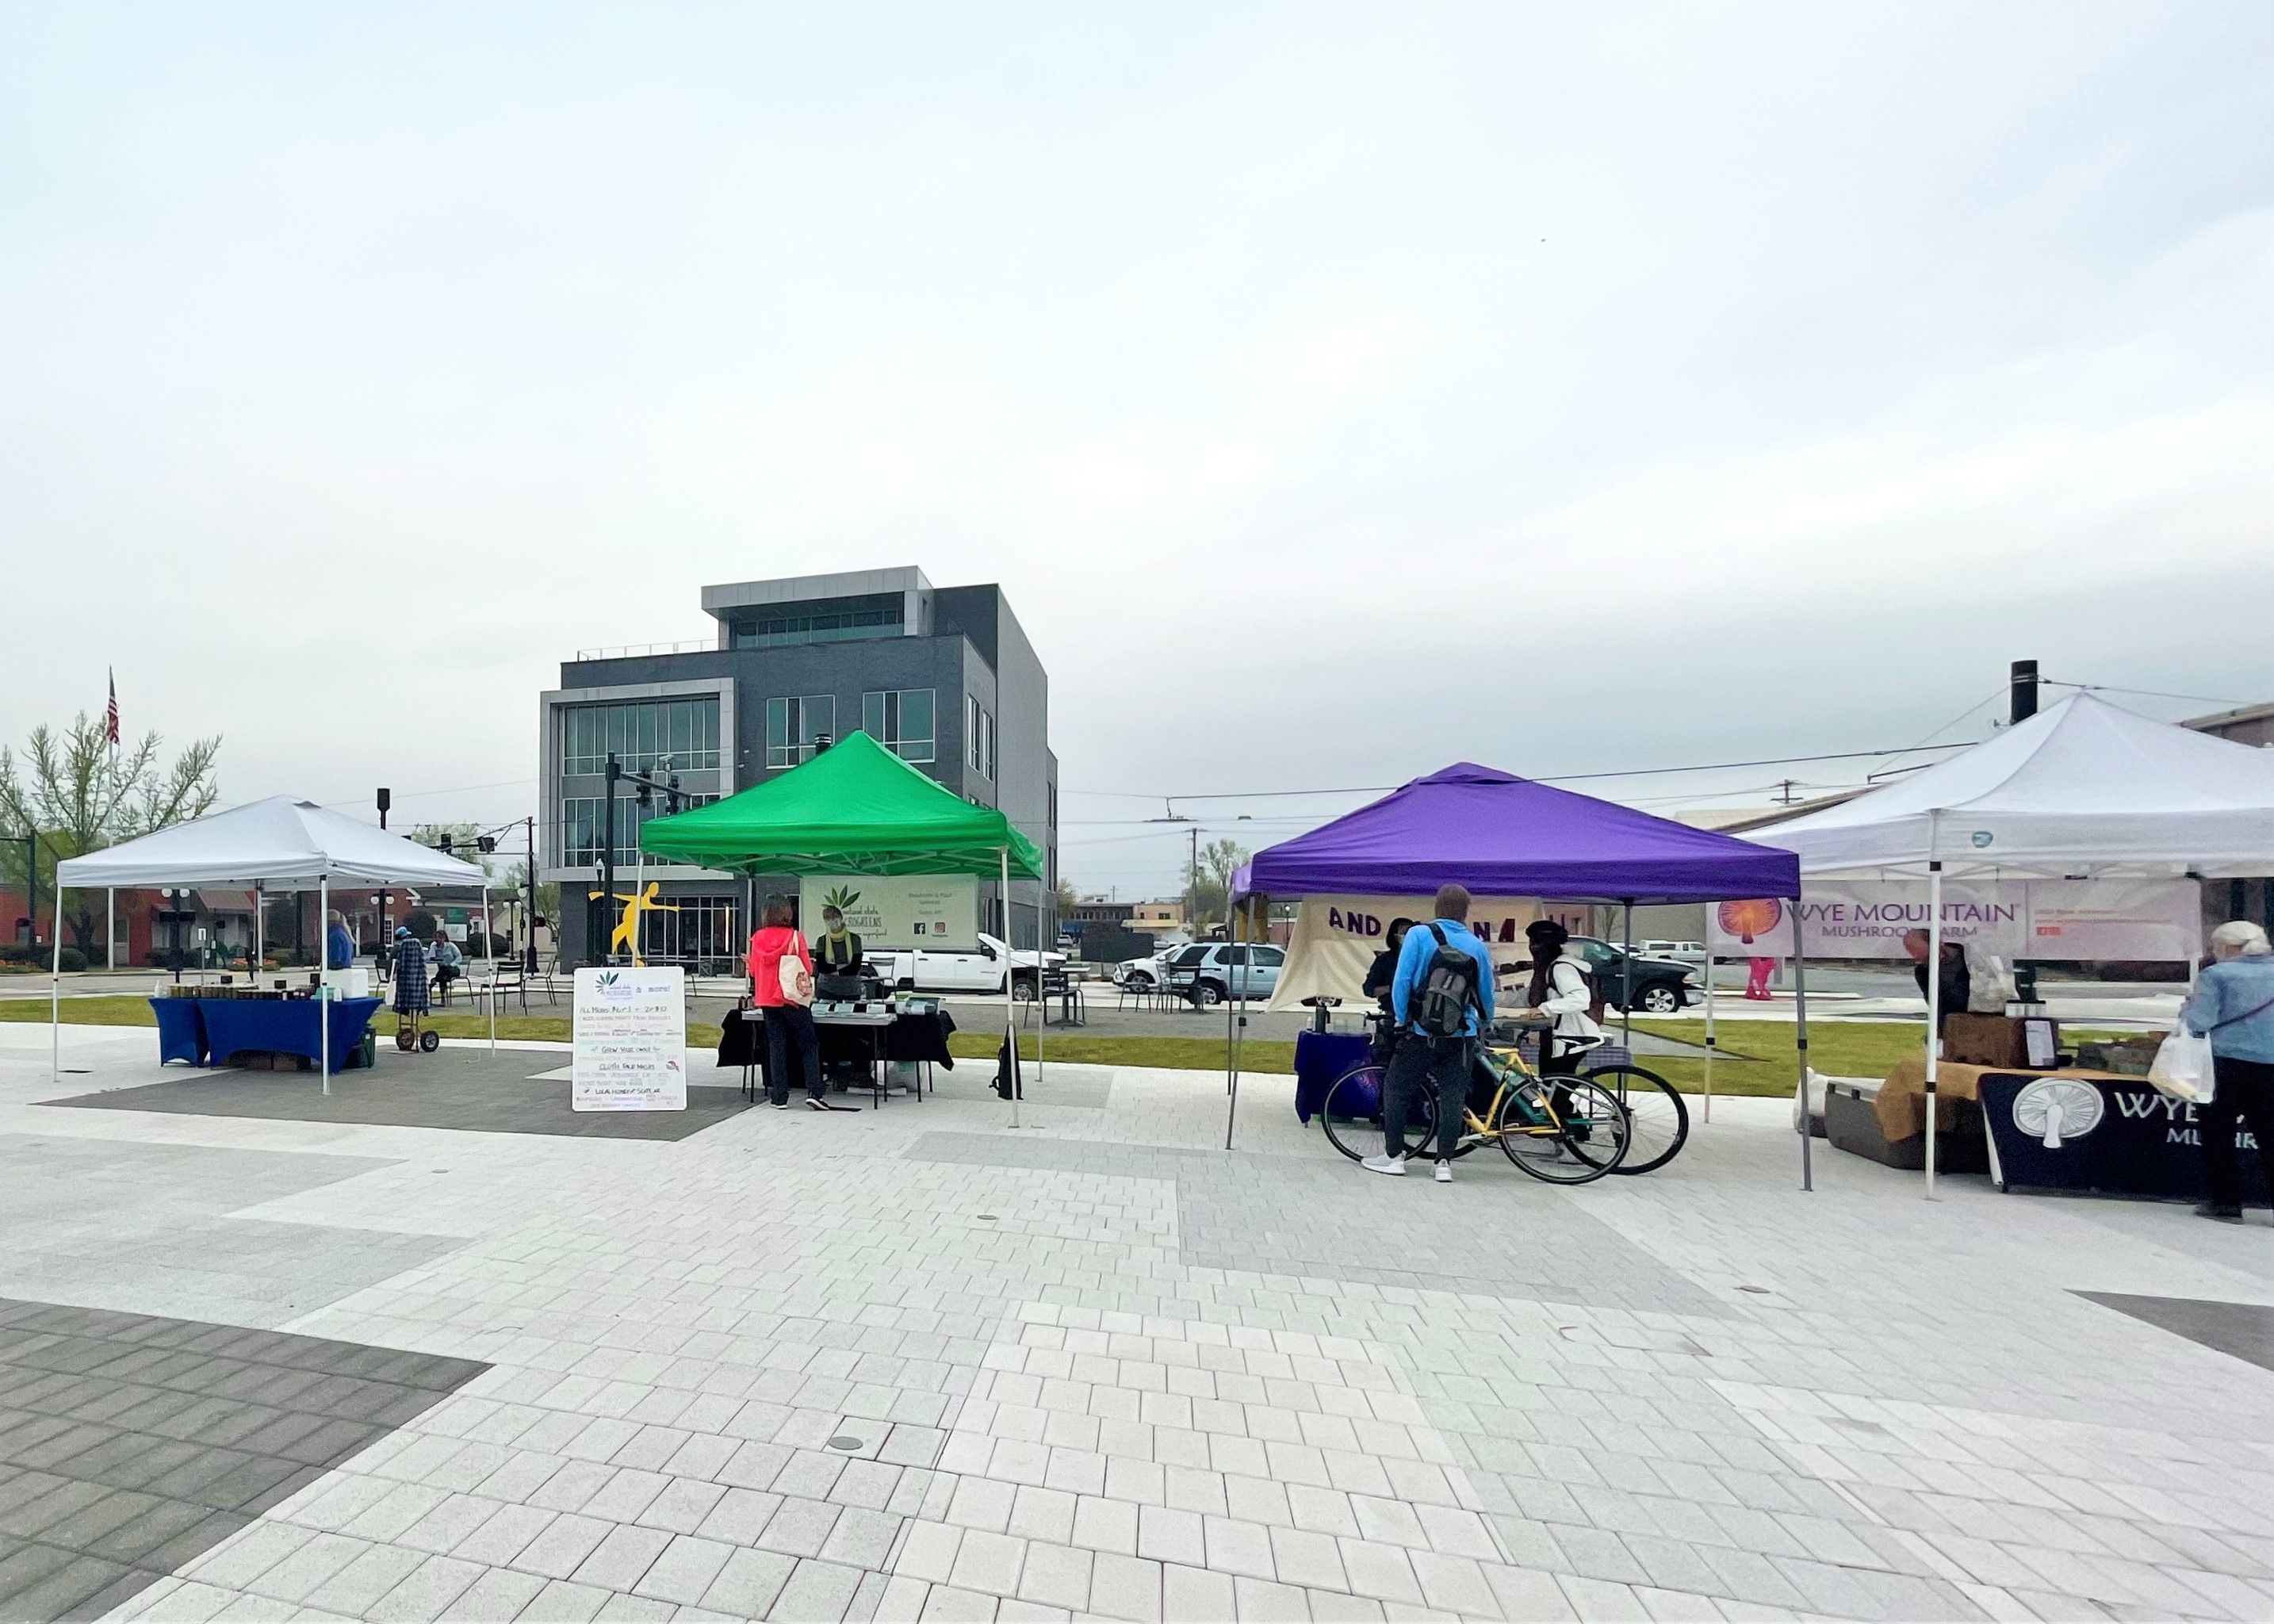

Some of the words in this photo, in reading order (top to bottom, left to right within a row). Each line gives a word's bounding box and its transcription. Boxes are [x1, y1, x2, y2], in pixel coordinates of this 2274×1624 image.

[1329, 906, 1381, 936] AND
[1786, 903, 1844, 921] WYE
[1855, 903, 2014, 922] MOUNTAIN
[1822, 925, 1911, 938] MUSHROO
[1939, 926, 1977, 938] ARM
[2114, 1091, 2199, 1122] WYE
